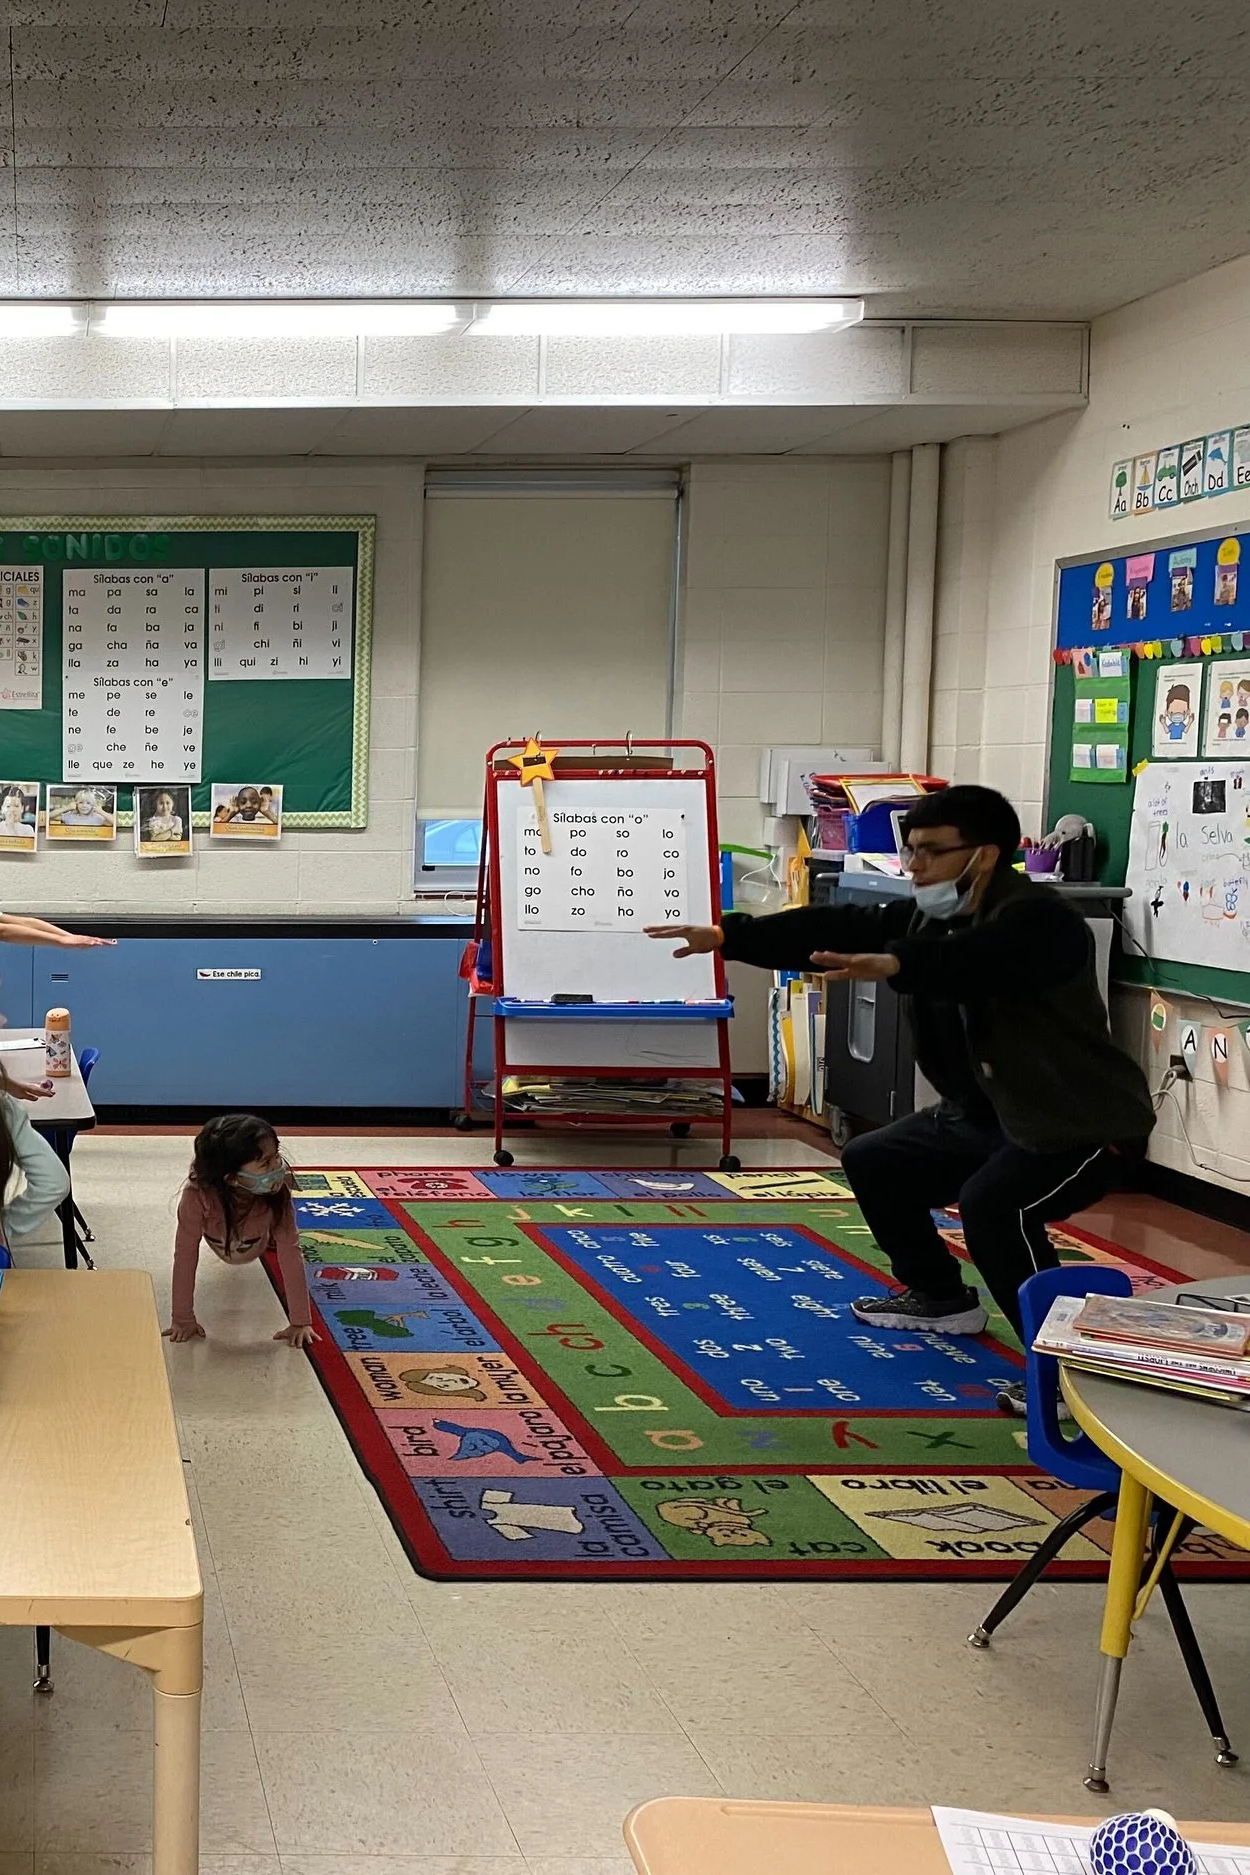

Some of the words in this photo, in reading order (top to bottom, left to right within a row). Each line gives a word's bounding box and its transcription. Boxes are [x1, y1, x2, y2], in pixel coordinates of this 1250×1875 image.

[1114, 497, 1126, 513] Aa
[1136, 492, 1149, 508] Bb
[1159, 486, 1172, 501] Cc
[1208, 471, 1223, 490] Dd
[23, 533, 171, 561] SONIDOS
[94, 574, 130, 583] Sílabas
[242, 573, 279, 582] Sílabas
[107, 589, 121, 598] pa
[185, 587, 194, 595] la
[215, 587, 227, 595] mi
[254, 586, 263, 597] pi
[294, 585, 300, 594] si
[69, 606, 78, 614] ta
[107, 605, 121, 614] da
[254, 604, 263, 613] di
[107, 623, 117, 632] fa
[146, 623, 159, 631] ba
[184, 623, 194, 632] ja
[215, 623, 223, 631] ni
[293, 621, 302, 630] bi
[69, 643, 82, 652] ga
[107, 641, 127, 649] cha
[146, 640, 159, 649] ña
[254, 639, 269, 648] chi
[293, 639, 301, 647] ñi
[332, 639, 340, 647] vi
[69, 659, 80, 667] lla
[146, 658, 158, 667] ha
[184, 660, 197, 668] ya
[94, 677, 130, 686] Sílabas
[107, 692, 120, 700] pe
[184, 691, 193, 699] le
[69, 708, 78, 716] te
[107, 708, 120, 716] de
[107, 725, 116, 733] fe
[145, 725, 158, 734] be
[107, 743, 126, 751] che
[145, 743, 158, 751] ñe
[93, 762, 112, 770] que
[151, 760, 164, 769] he
[554, 813, 597, 823] Sílabas
[570, 830, 586, 839] po
[663, 829, 673, 838] lo
[1176, 822, 1188, 848] la
[1201, 823, 1233, 845] Selva
[525, 846, 536, 855] to
[571, 847, 586, 856] do
[571, 866, 582, 876] fo
[617, 868, 633, 877] bo
[664, 868, 675, 879] jo
[525, 887, 541, 897] go
[571, 886, 594, 896] cho
[618, 887, 633, 896] ño
[525, 905, 539, 914] llo
[618, 907, 633, 916] ho
[665, 910, 680, 919] yo
[226, 969, 243, 977] chile
[1184, 1029, 1195, 1052] A
[1213, 1038, 1227, 1059] N
[347, 1327, 373, 1350] tree
[693, 1338, 730, 1359] dos
[765, 1338, 805, 1360] two
[360, 1357, 404, 1401] woman
[476, 1356, 523, 1390] mujer
[740, 1379, 781, 1402] uno
[816, 1379, 860, 1402] one
[498, 1393, 533, 1404] la
[388, 1424, 438, 1458] bird
[518, 1411, 588, 1459] pájaro
[543, 1463, 586, 1475] el
[840, 1478, 952, 1496] libro
[946, 1479, 989, 1496] el
[424, 1477, 475, 1519] shirt
[582, 1493, 649, 1558] camisa
[573, 1540, 609, 1558] la
[789, 1539, 868, 1557] cat
